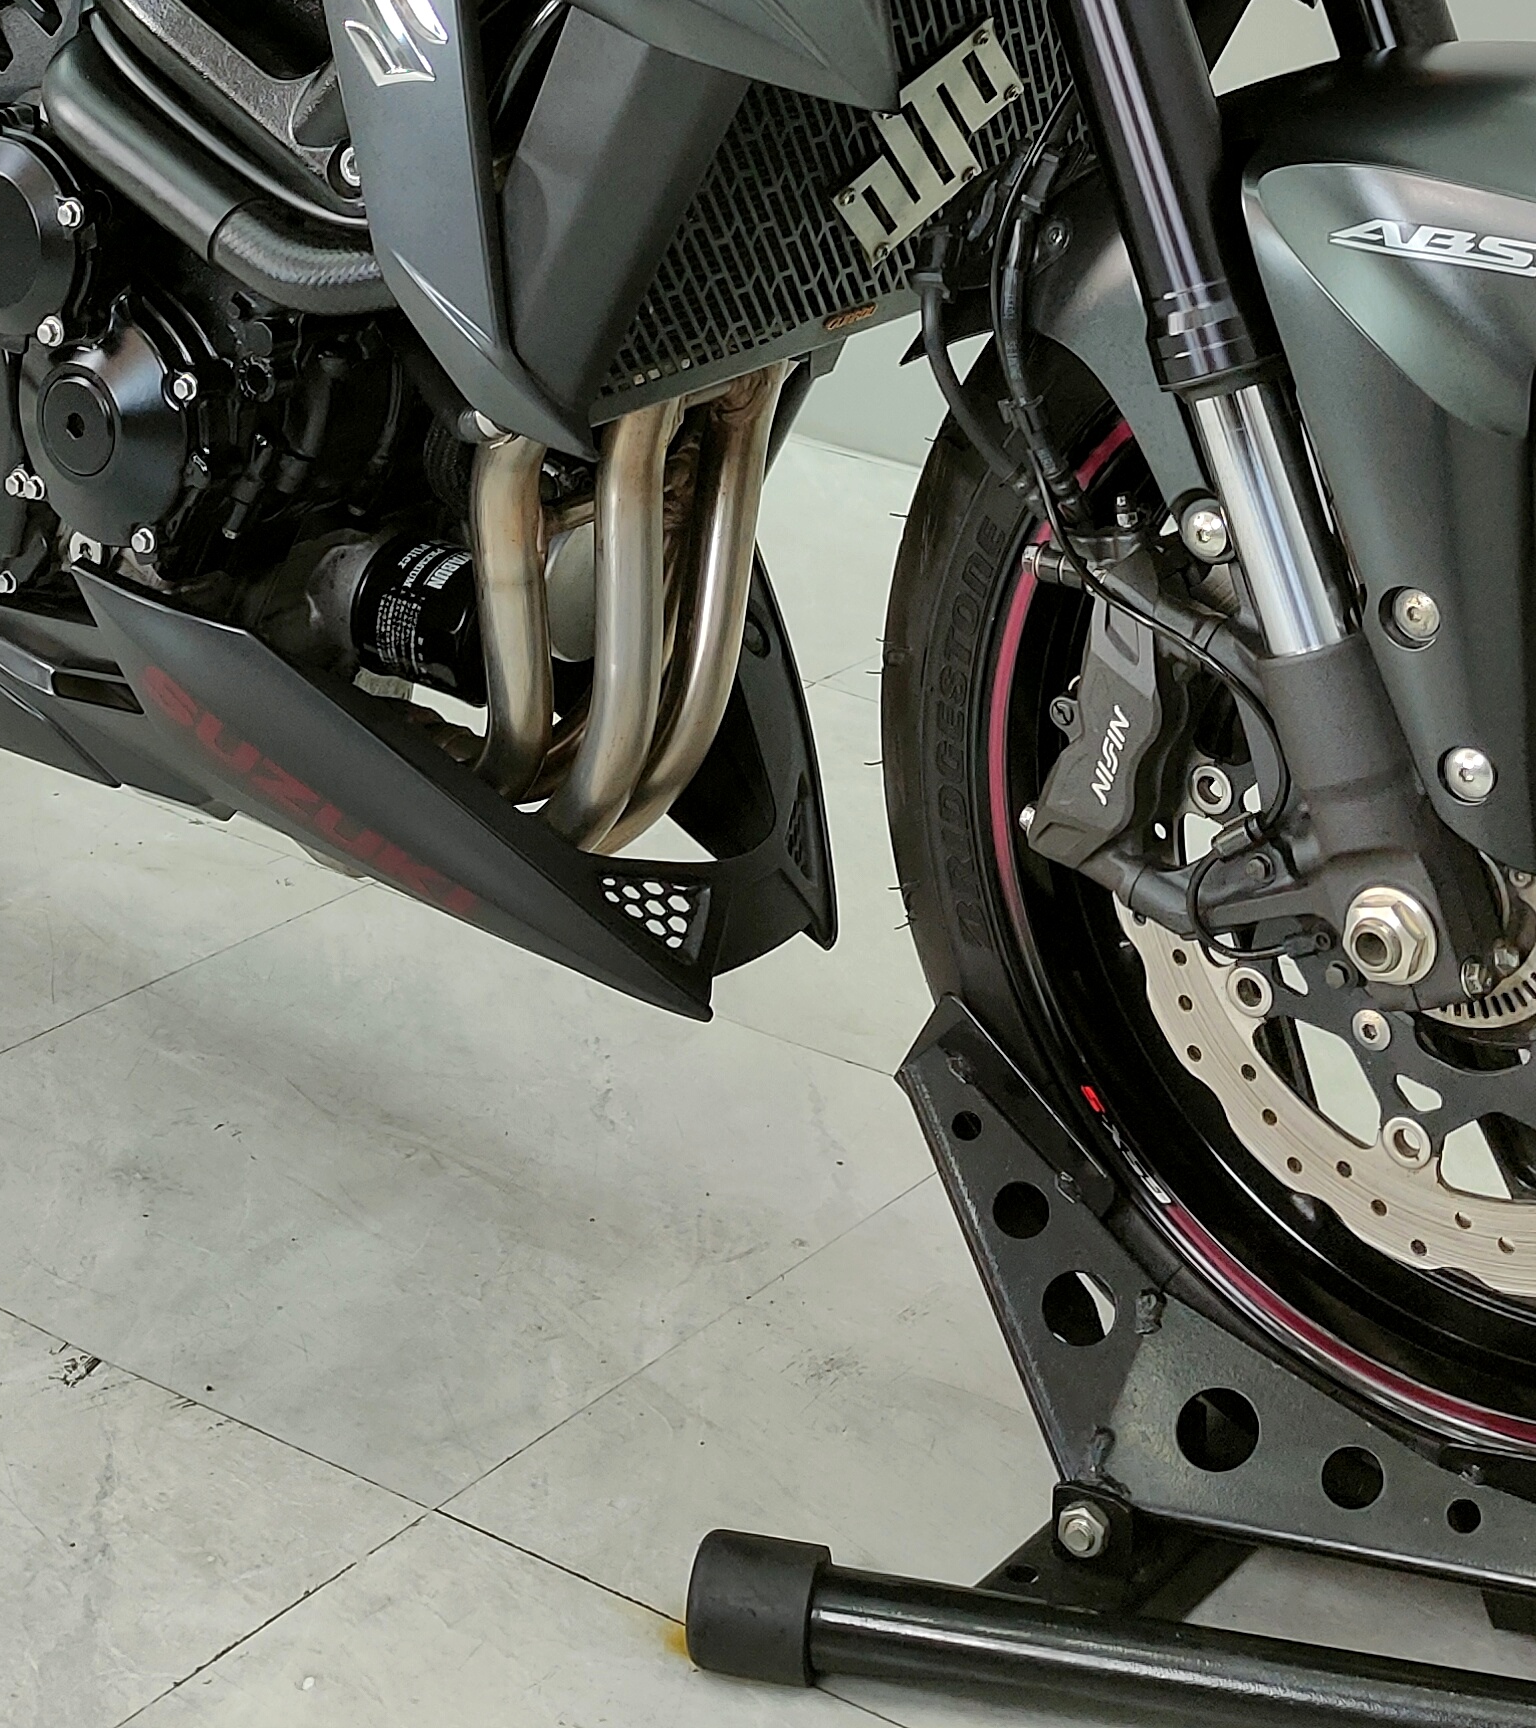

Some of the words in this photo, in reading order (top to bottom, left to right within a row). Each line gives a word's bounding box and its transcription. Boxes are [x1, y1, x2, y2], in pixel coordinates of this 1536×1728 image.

[403, 548, 446, 588] PREMIUM
[140, 666, 477, 913] SUZUKI
[934, 513, 1006, 950] BRIDGESTONE
